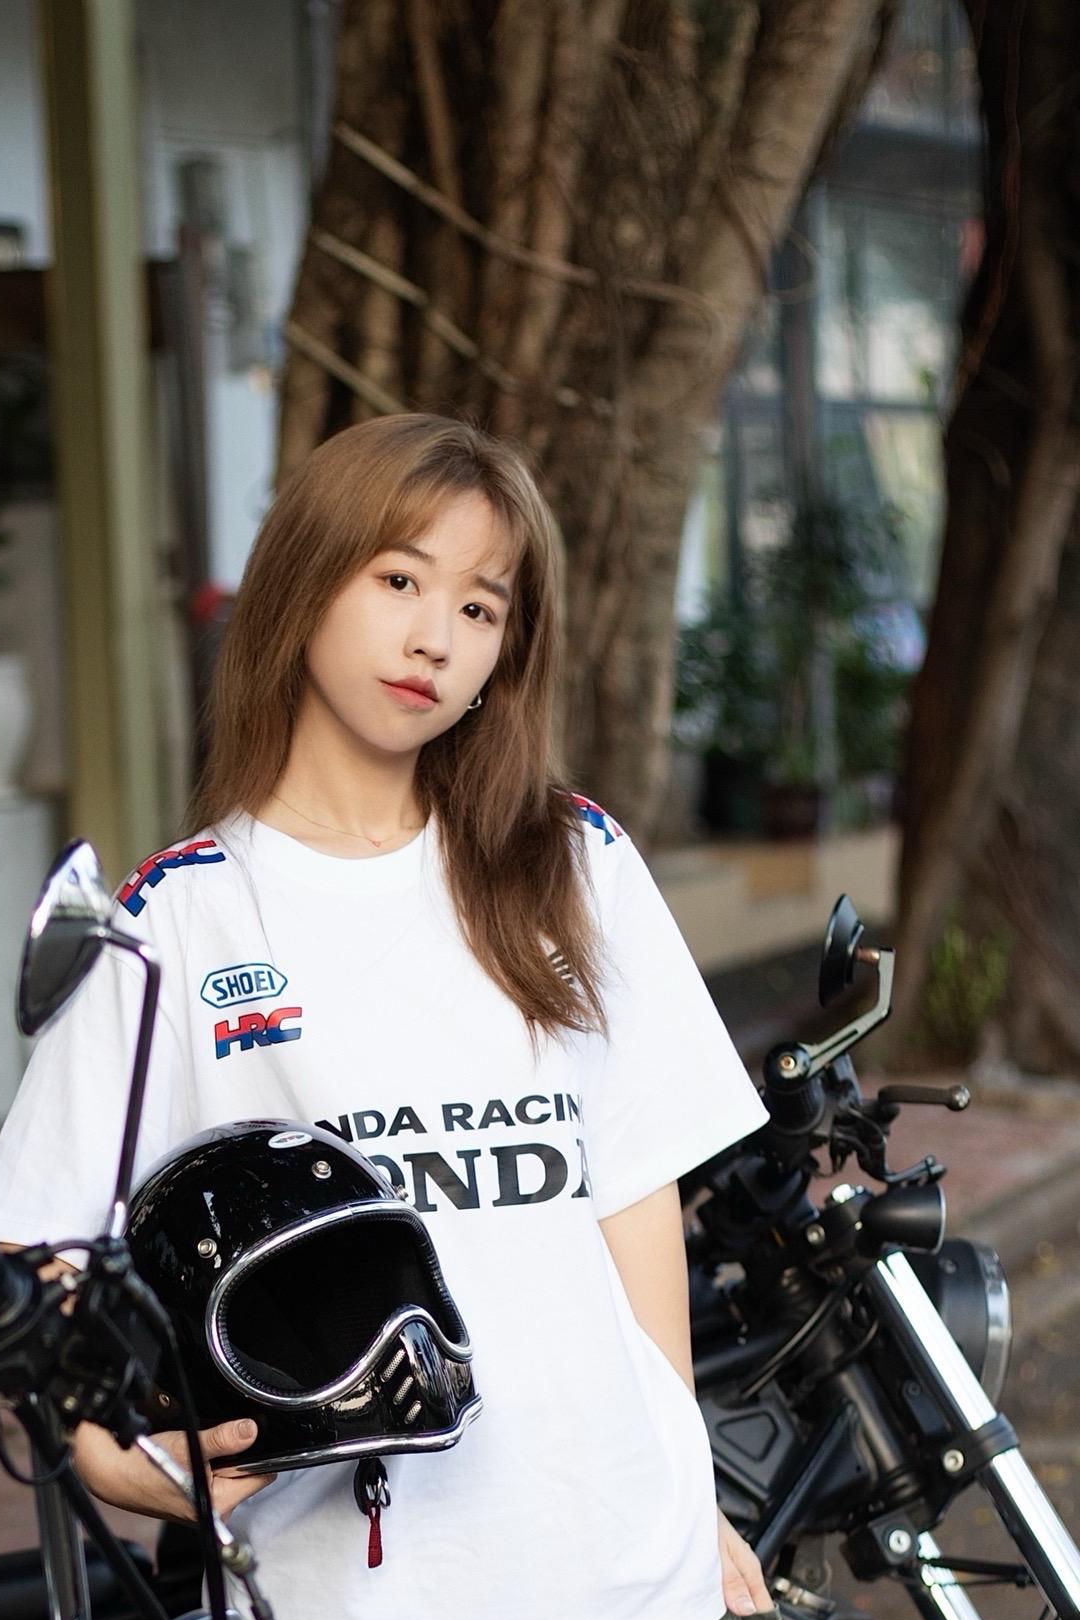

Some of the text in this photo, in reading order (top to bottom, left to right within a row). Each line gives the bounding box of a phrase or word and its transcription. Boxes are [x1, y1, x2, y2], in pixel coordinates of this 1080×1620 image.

[212, 970, 276, 1002] SHOEI
[214, 1006, 303, 1060] HRC
[314, 1093, 584, 1143] NDA RACIN
